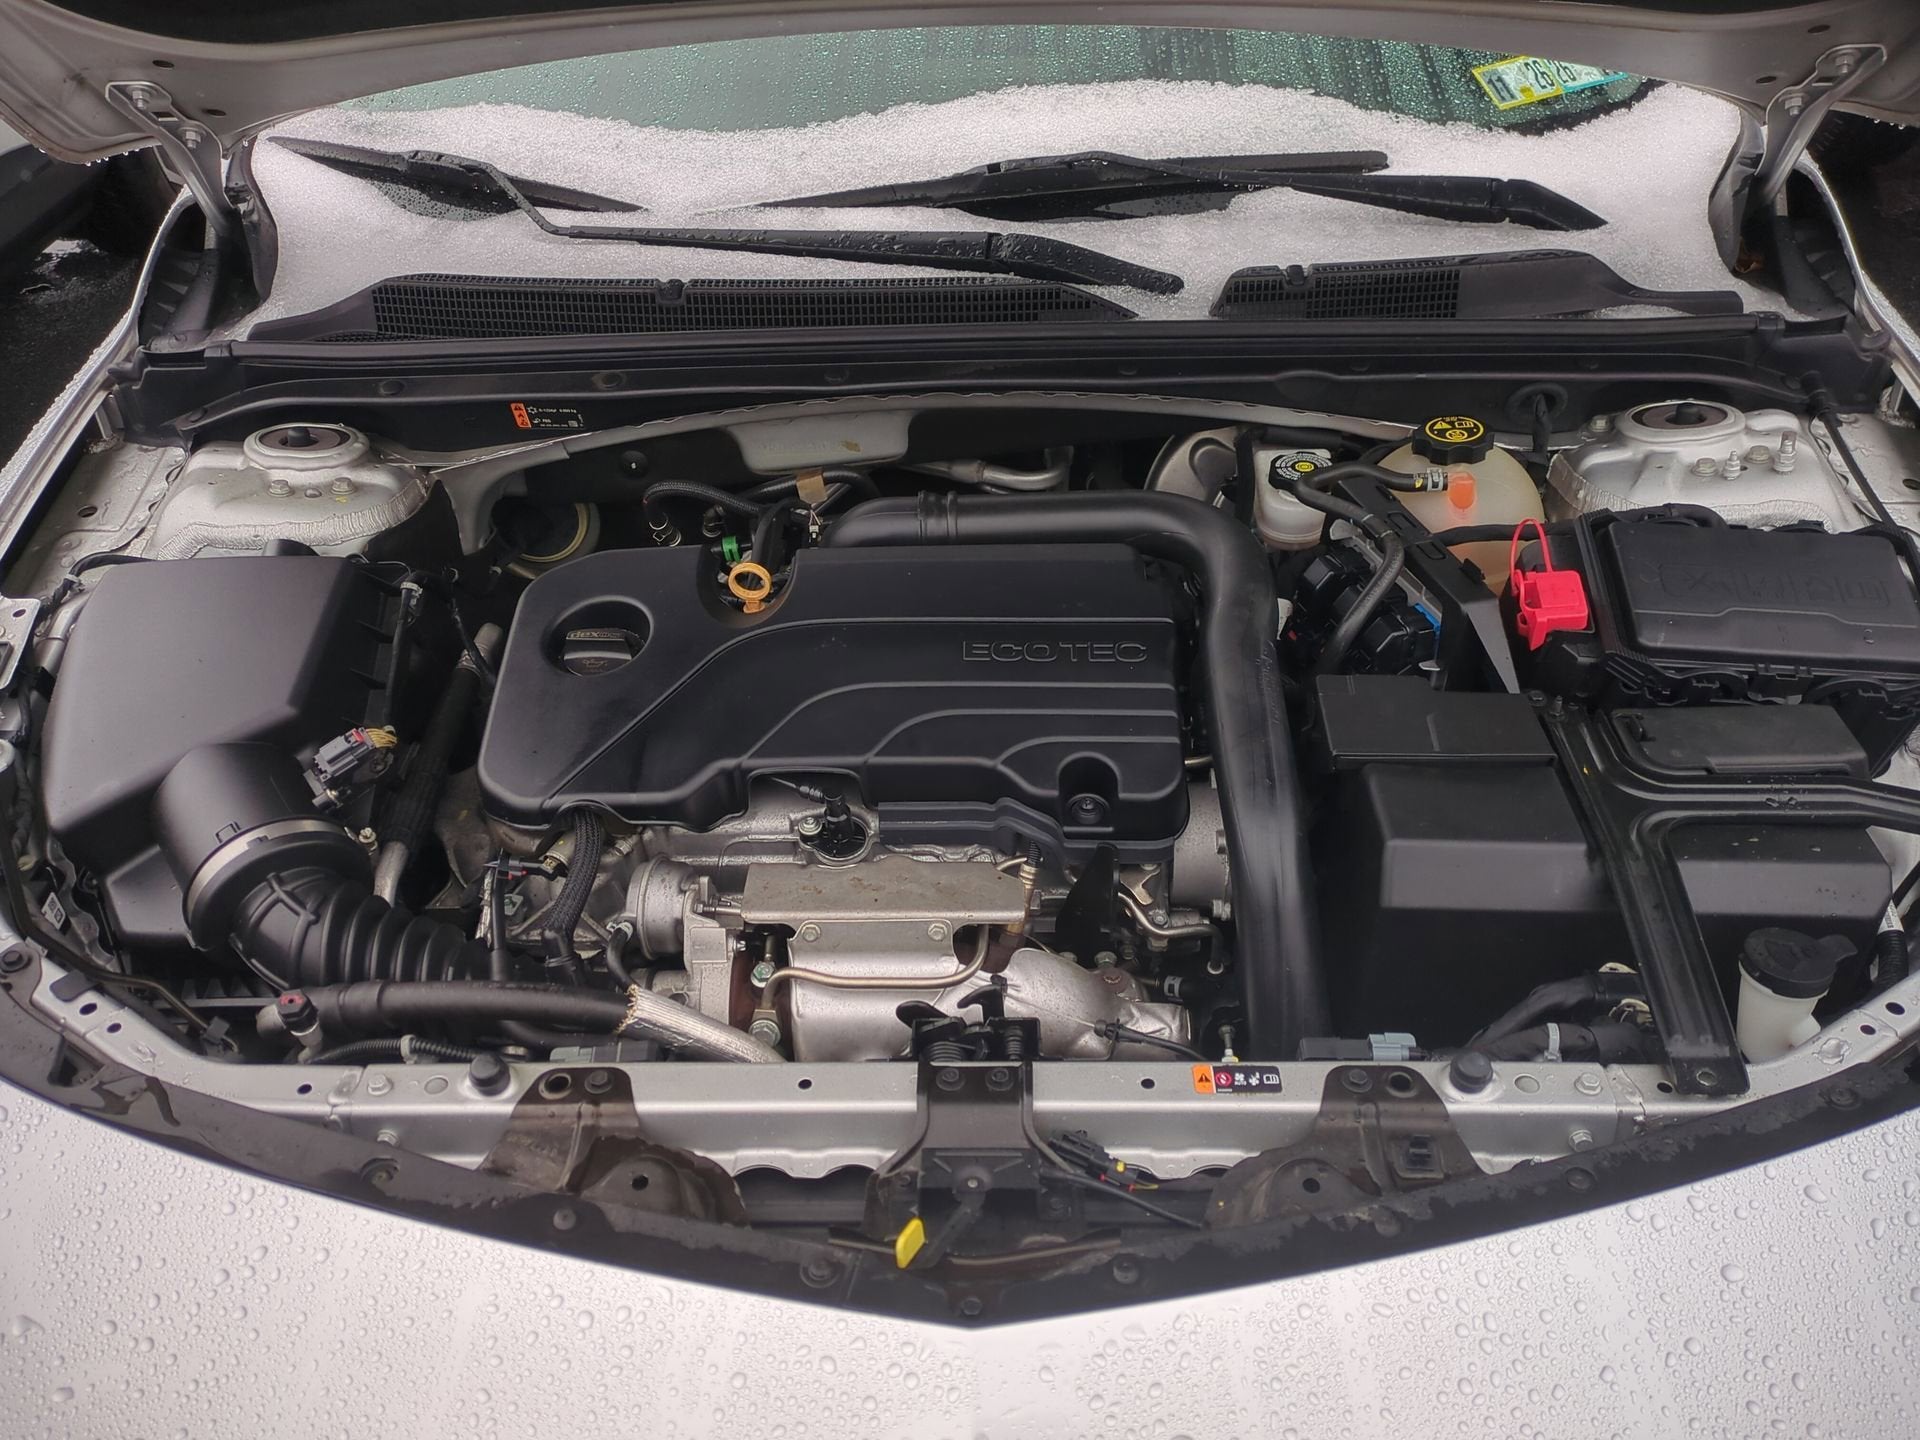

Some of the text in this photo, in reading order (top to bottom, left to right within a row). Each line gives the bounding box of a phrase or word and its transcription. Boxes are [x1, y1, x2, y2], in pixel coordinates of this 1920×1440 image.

[1487, 59, 1556, 102] 11 26
[1553, 60, 1577, 84] 26
[962, 640, 1148, 663] ECOTEC
